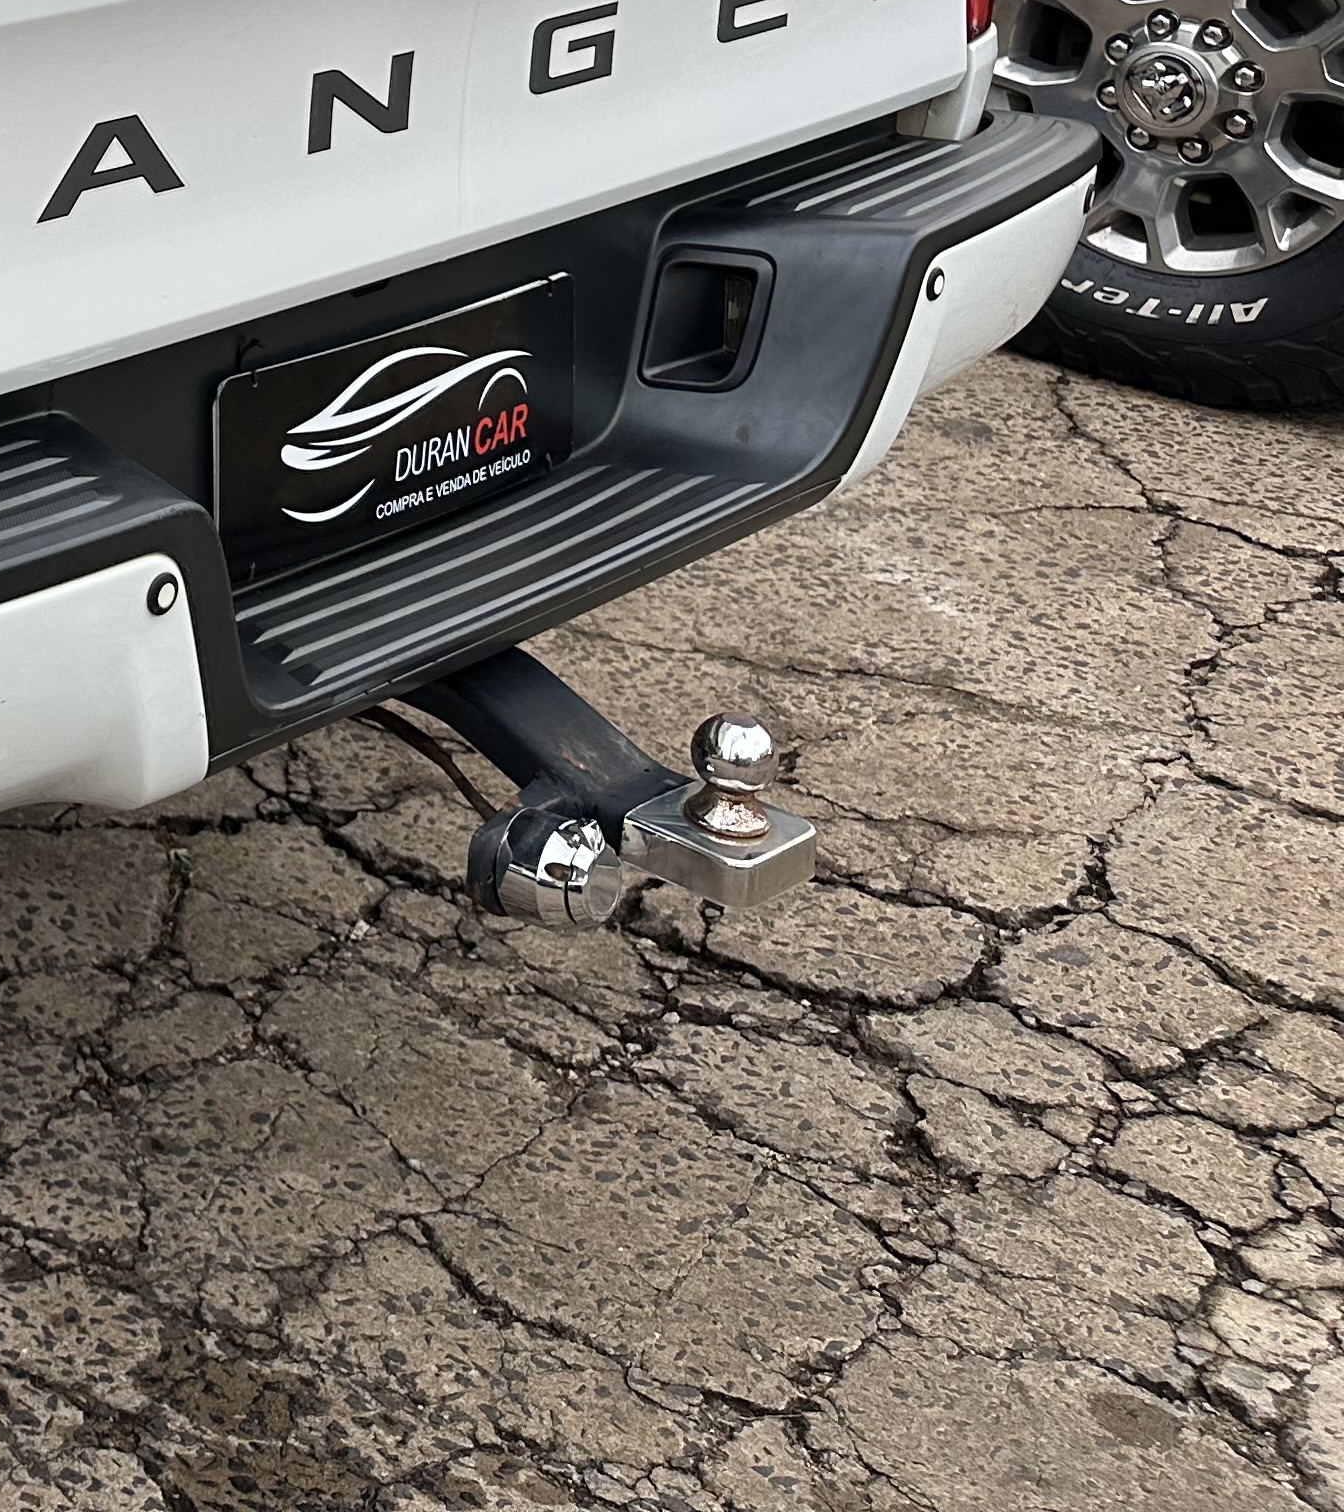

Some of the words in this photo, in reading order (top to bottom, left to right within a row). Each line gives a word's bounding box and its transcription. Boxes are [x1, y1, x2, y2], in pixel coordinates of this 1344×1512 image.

[394, 425, 471, 482] DURAN
[474, 403, 529, 456] CAR
[375, 490, 425, 519] COMPRA
[426, 487, 433, 502] E
[435, 472, 472, 497] VENDA
[472, 466, 488, 484] DE
